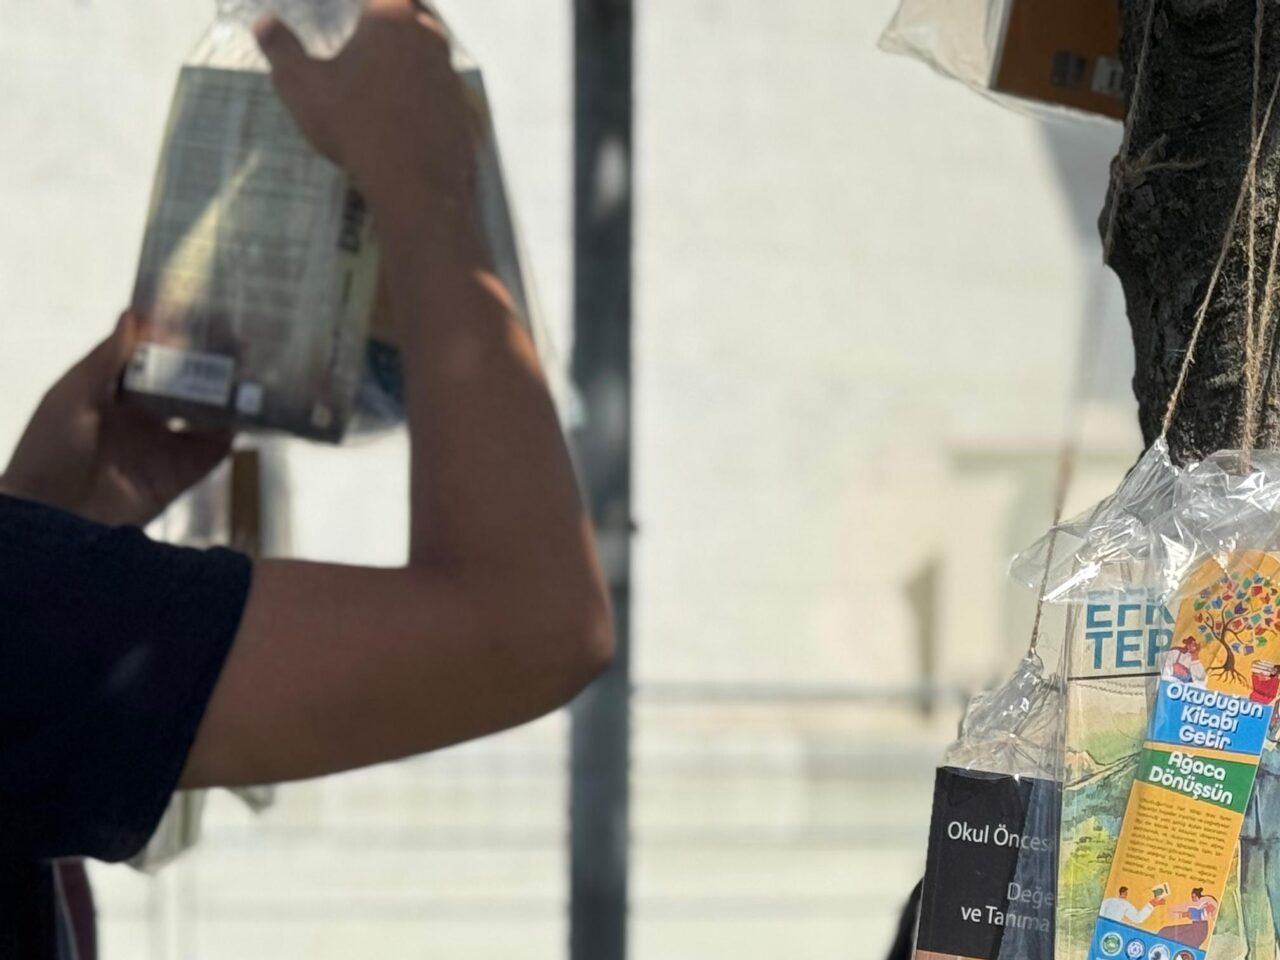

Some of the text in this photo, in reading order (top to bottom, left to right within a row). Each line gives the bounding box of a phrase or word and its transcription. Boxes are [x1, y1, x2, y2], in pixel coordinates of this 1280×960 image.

[1166, 682, 1264, 719] Okuduğun
[1181, 704, 1239, 734] Kitabı
[1179, 725, 1232, 750] Getir
[1168, 751, 1227, 781] Ağaca
[1148, 765, 1234, 805] Dönüşsün
[947, 820, 989, 844] Okul
[961, 905, 1050, 933] ve Tanıma
